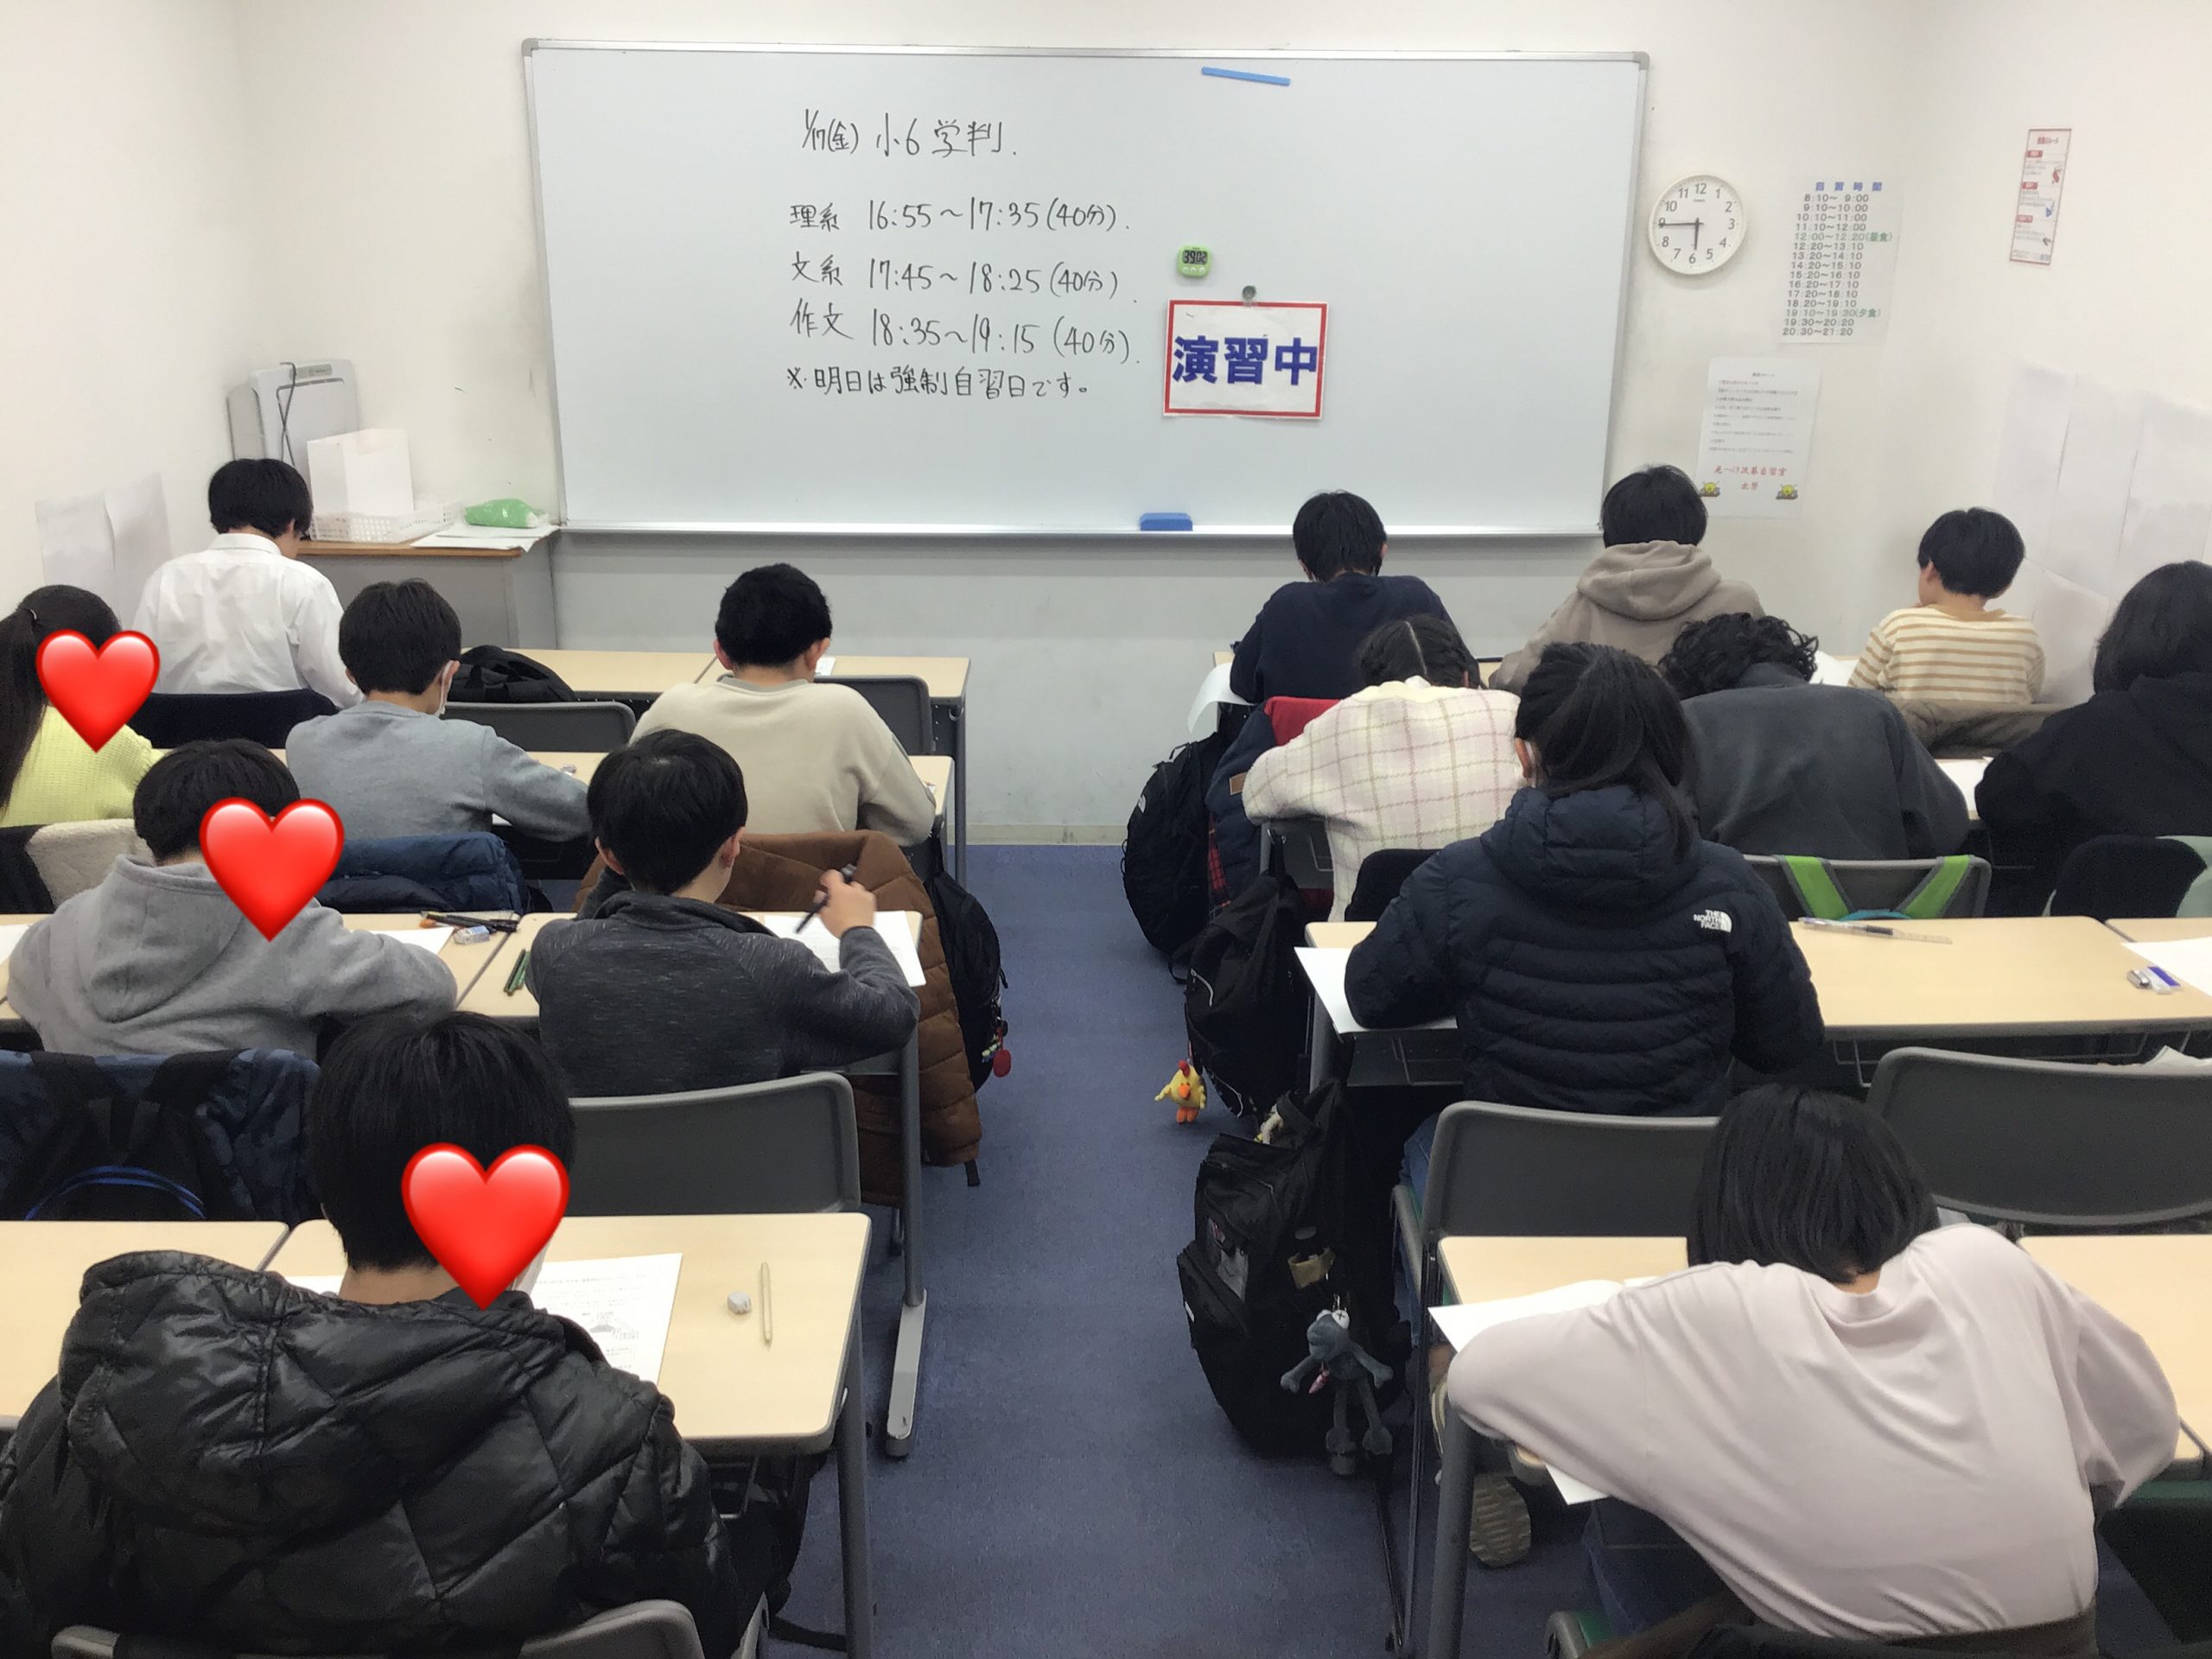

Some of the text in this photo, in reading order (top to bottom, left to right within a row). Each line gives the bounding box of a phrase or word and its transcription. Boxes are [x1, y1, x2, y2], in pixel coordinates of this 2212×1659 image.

[1678, 188, 1688, 199] 11
[1694, 182, 1707, 194] 12
[1715, 188, 1720, 199] 1
[1665, 200, 1677, 212] 10
[1725, 201, 1732, 213] 2
[789, 201, 840, 232] 理系
[1659, 217, 1666, 228] 9
[1728, 219, 1735, 229] 3
[1662, 236, 1669, 247] 8
[1719, 237, 1726, 248] 4
[1674, 248, 1681, 259] 7
[1688, 253, 1696, 264] 6
[1707, 248, 1713, 259] 5
[791, 251, 844, 286] 文系
[790, 297, 855, 340] 作文
[1173, 335, 1318, 385] 演習中
